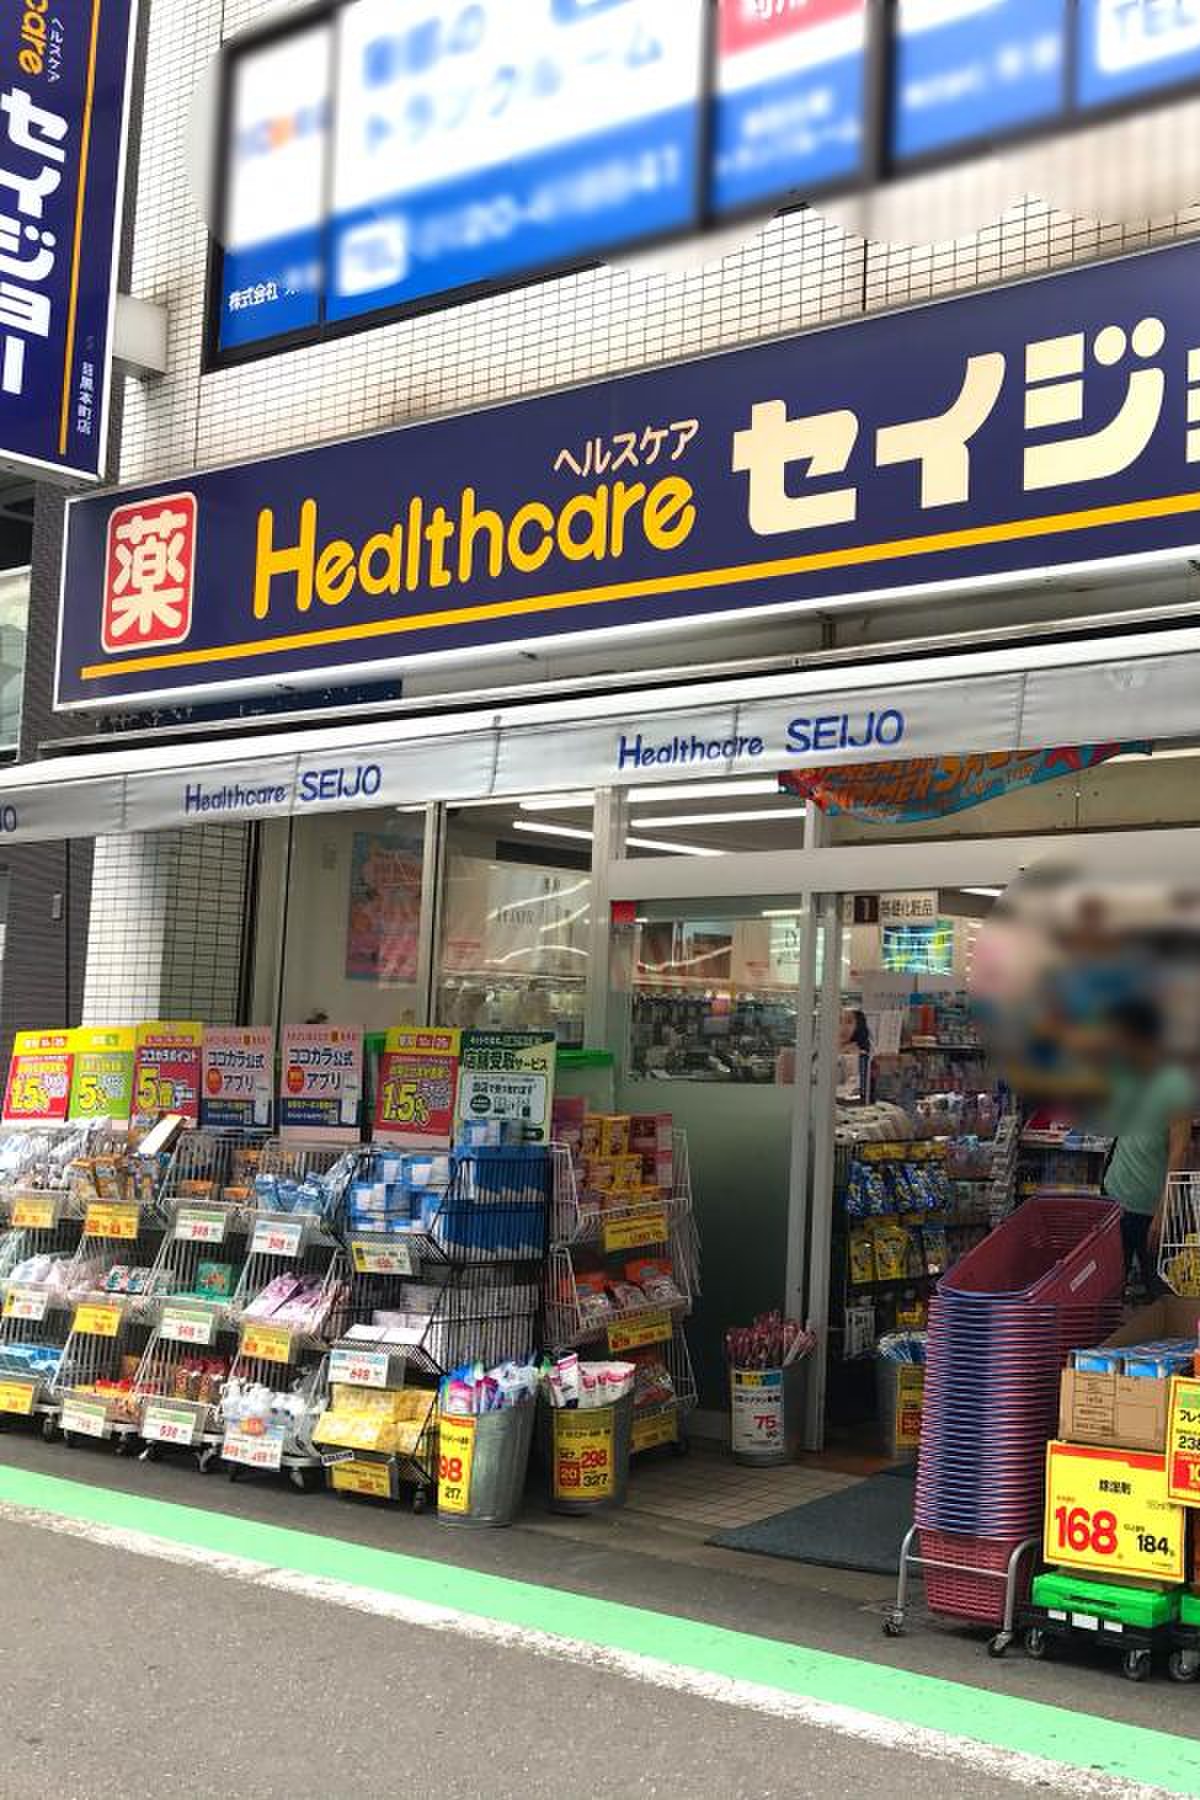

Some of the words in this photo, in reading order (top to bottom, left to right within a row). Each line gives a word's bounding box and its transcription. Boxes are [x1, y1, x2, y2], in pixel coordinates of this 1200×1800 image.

[553, 419, 700, 477] ヘルスケア
[252, 475, 696, 620] Healthcare
[110, 509, 187, 636] 薬
[618, 733, 764, 769] Healthcare
[786, 709, 905, 753] SEIJO
[184, 783, 287, 813] Healthcare
[300, 765, 382, 801] SEIJO
[208, 1049, 266, 1068] ココカラ公式
[288, 1048, 353, 1067] ココカラ公式
[223, 1073, 255, 1093] アプリ
[306, 1072, 340, 1092] アプリ
[754, 1415, 777, 1430] 75
[1055, 1506, 1118, 1555] 168
[1136, 1534, 1169, 1555] 184
